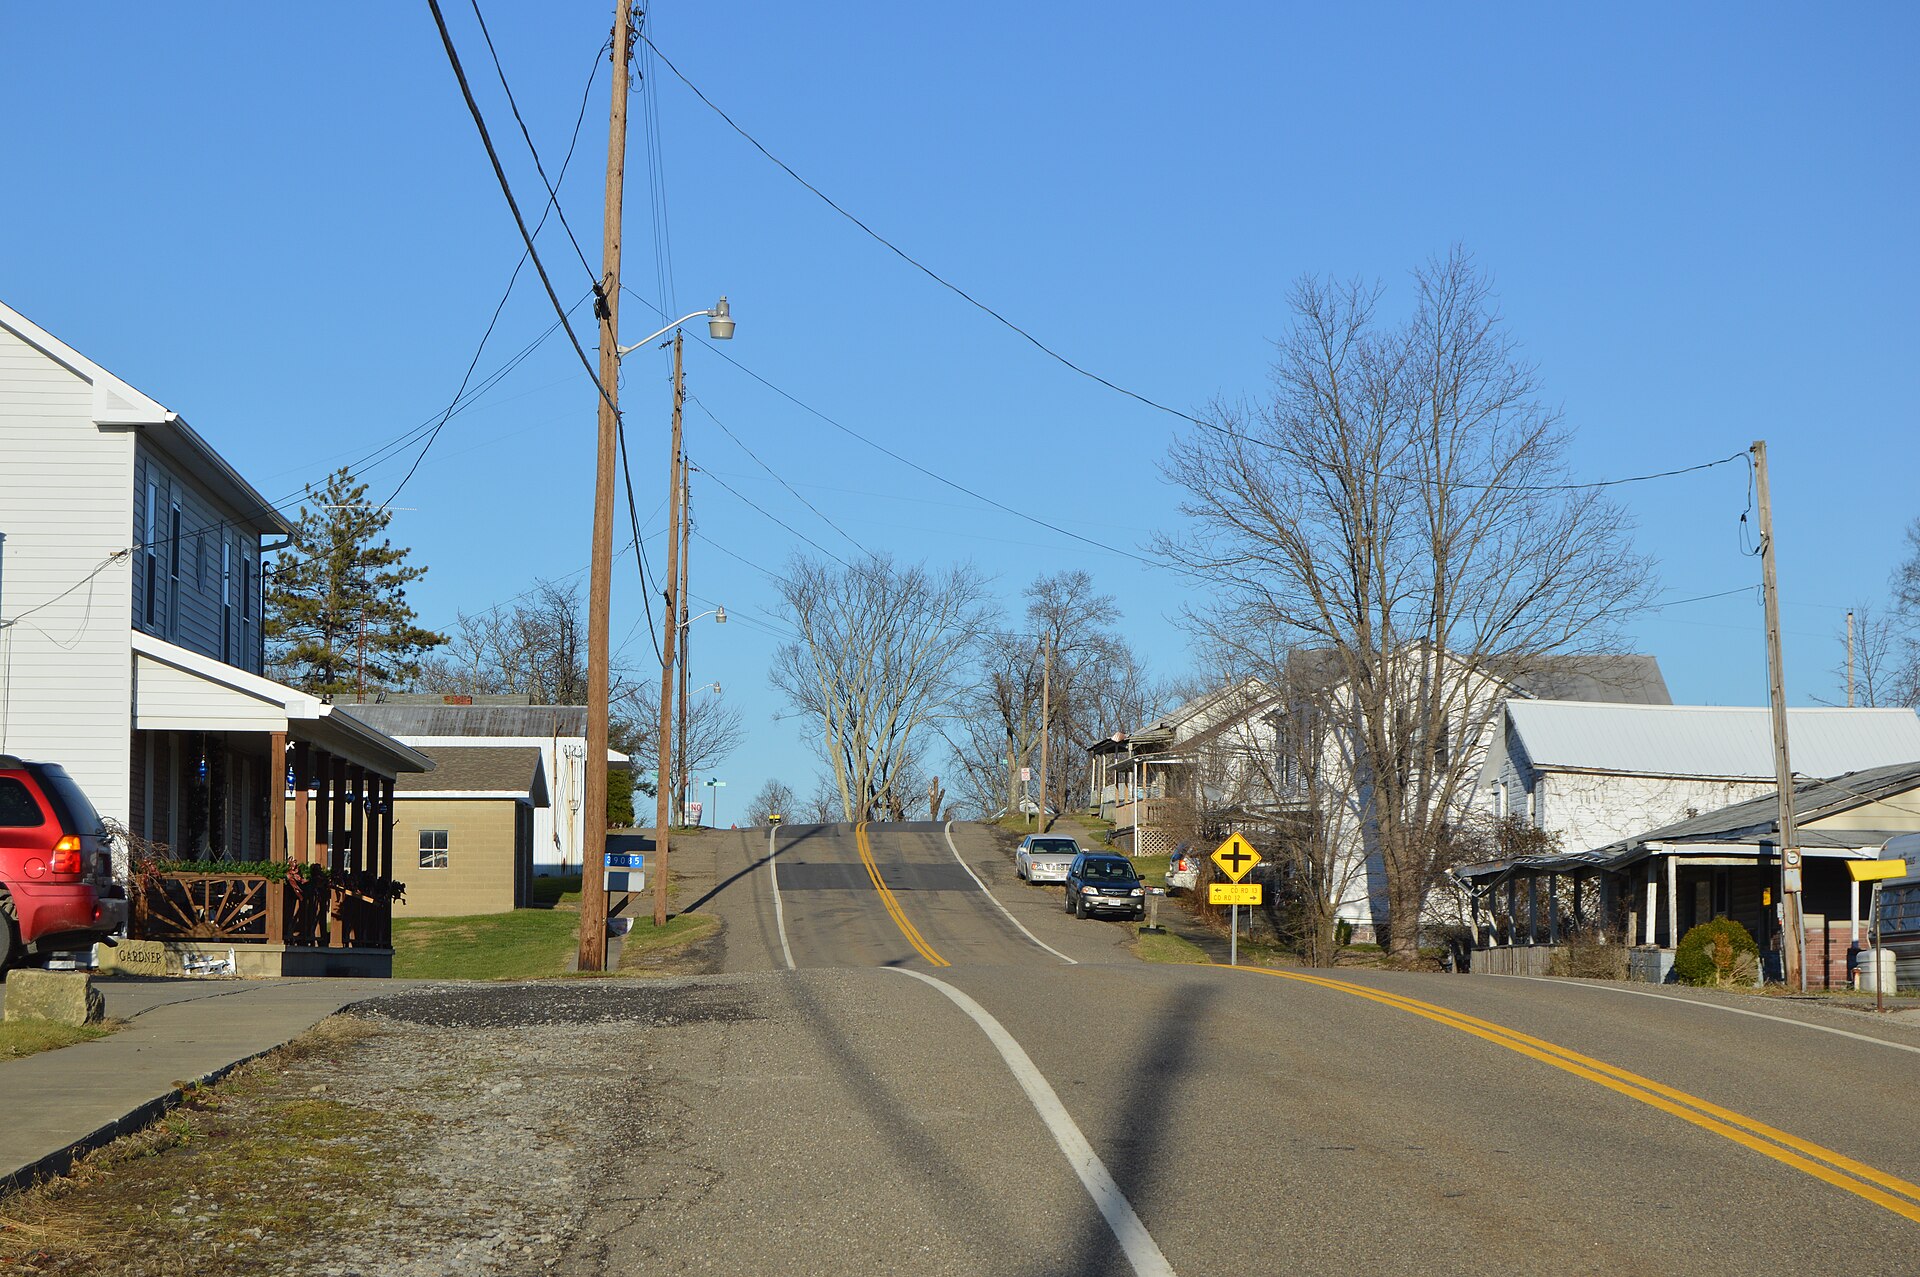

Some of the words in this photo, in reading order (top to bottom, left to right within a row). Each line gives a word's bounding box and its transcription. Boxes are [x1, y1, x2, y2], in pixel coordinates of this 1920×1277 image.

[691, 803, 702, 811] NO
[606, 856, 640, 865] 39085
[119, 950, 161, 964] GARDNER
